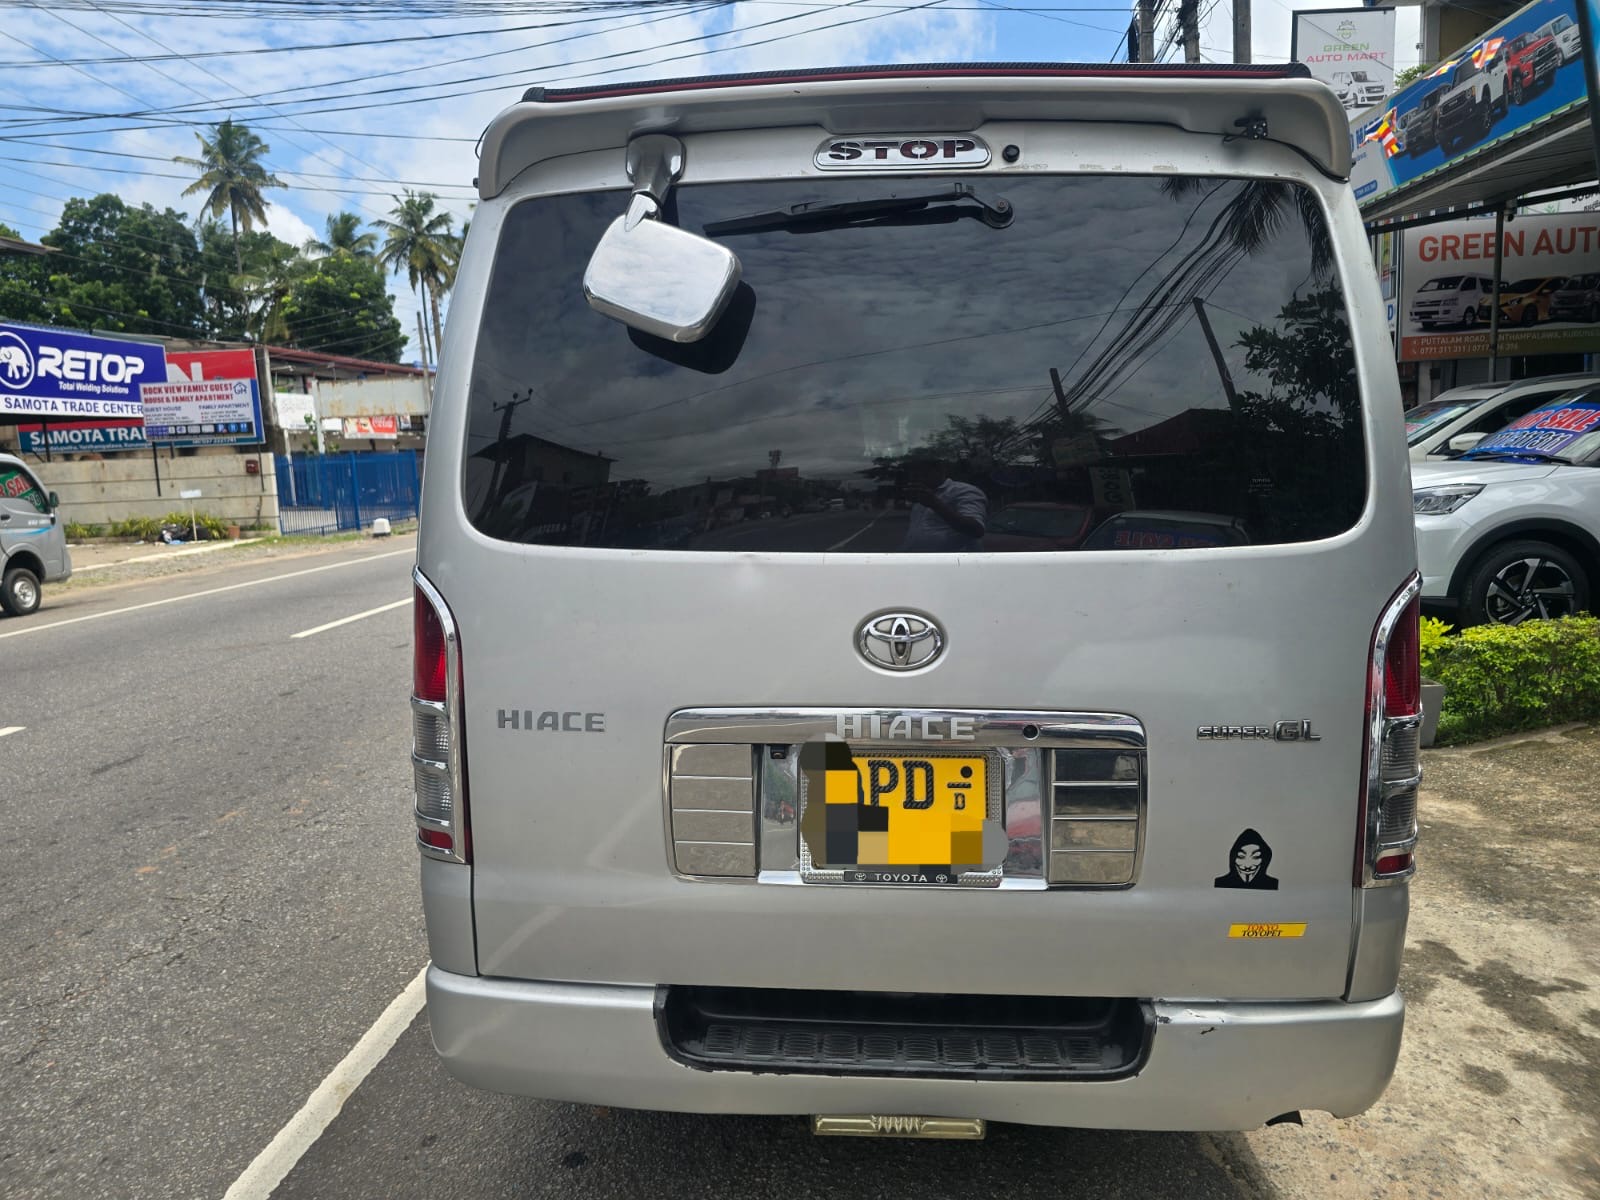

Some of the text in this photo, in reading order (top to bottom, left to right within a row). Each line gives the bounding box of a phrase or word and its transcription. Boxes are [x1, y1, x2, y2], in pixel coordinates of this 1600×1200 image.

[1323, 43, 1370, 52] GREEN
[1306, 51, 1387, 63] AUTO MART
[828, 139, 976, 160] STOP
[1418, 226, 1600, 262] GREEN AUT
[1420, 336, 1463, 346] PUTTALAM
[37, 346, 145, 384] RETOP
[58, 381, 129, 394] Total Welding Solutions
[143, 383, 233, 395] ROCK VIEW FAMILY GUEST
[5, 397, 58, 412] SAMOTA
[62, 401, 99, 413] TRADE
[103, 403, 143, 415] CENTER
[144, 396, 164, 404] HOUSE
[172, 395, 194, 403] FAMILY
[195, 393, 234, 402] APARTMENT
[1536, 407, 1600, 432] SALE
[30, 428, 105, 445] SAMOTA
[497, 709, 605, 732] HIACE
[836, 714, 976, 740] HIACE
[1197, 719, 1322, 741] SUPER GL
[875, 873, 928, 882] TOYOTA
[1242, 929, 1284, 937] TOYOPET
